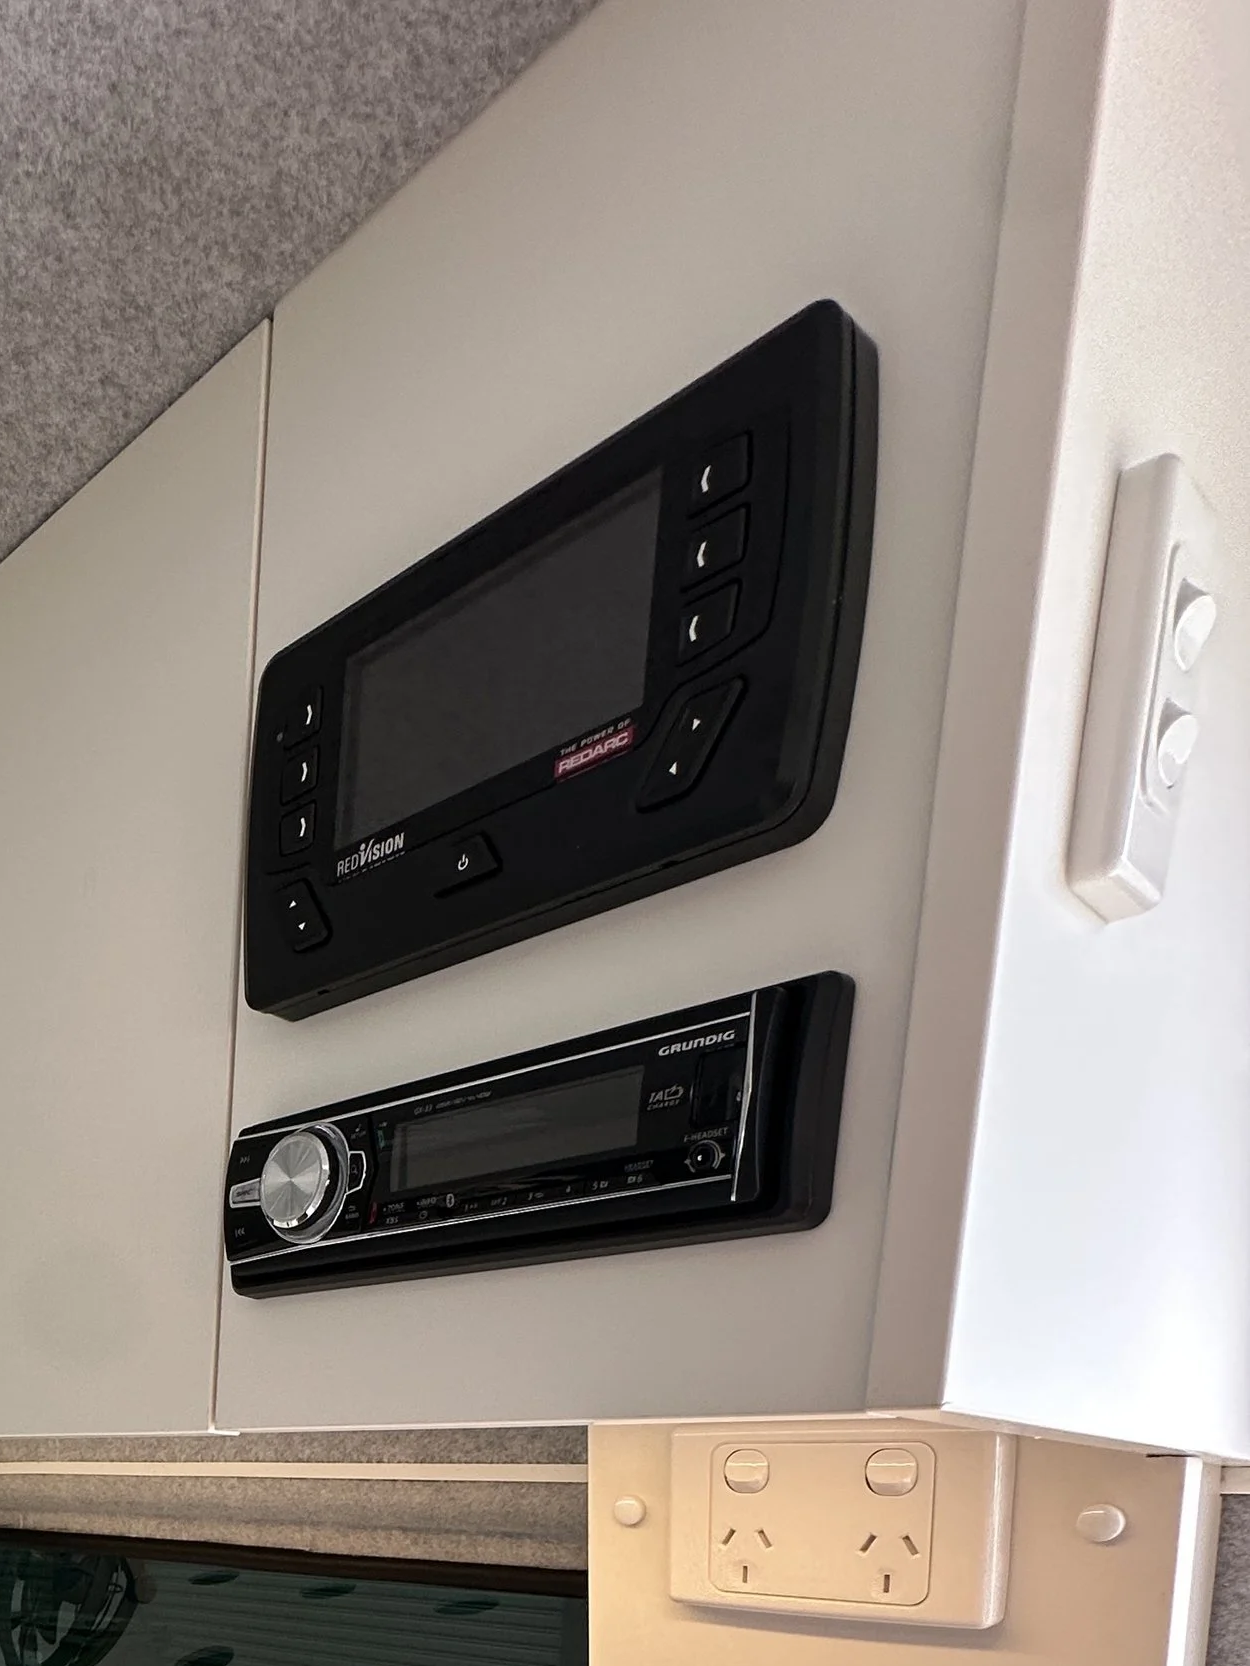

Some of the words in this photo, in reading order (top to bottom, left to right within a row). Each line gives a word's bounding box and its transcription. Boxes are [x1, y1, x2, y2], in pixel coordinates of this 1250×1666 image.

[557, 731, 630, 774] REDARC
[559, 742, 578, 756] THE
[580, 726, 615, 748] POWER
[617, 717, 632, 730] OF
[657, 1029, 736, 1057] GRUNDIG
